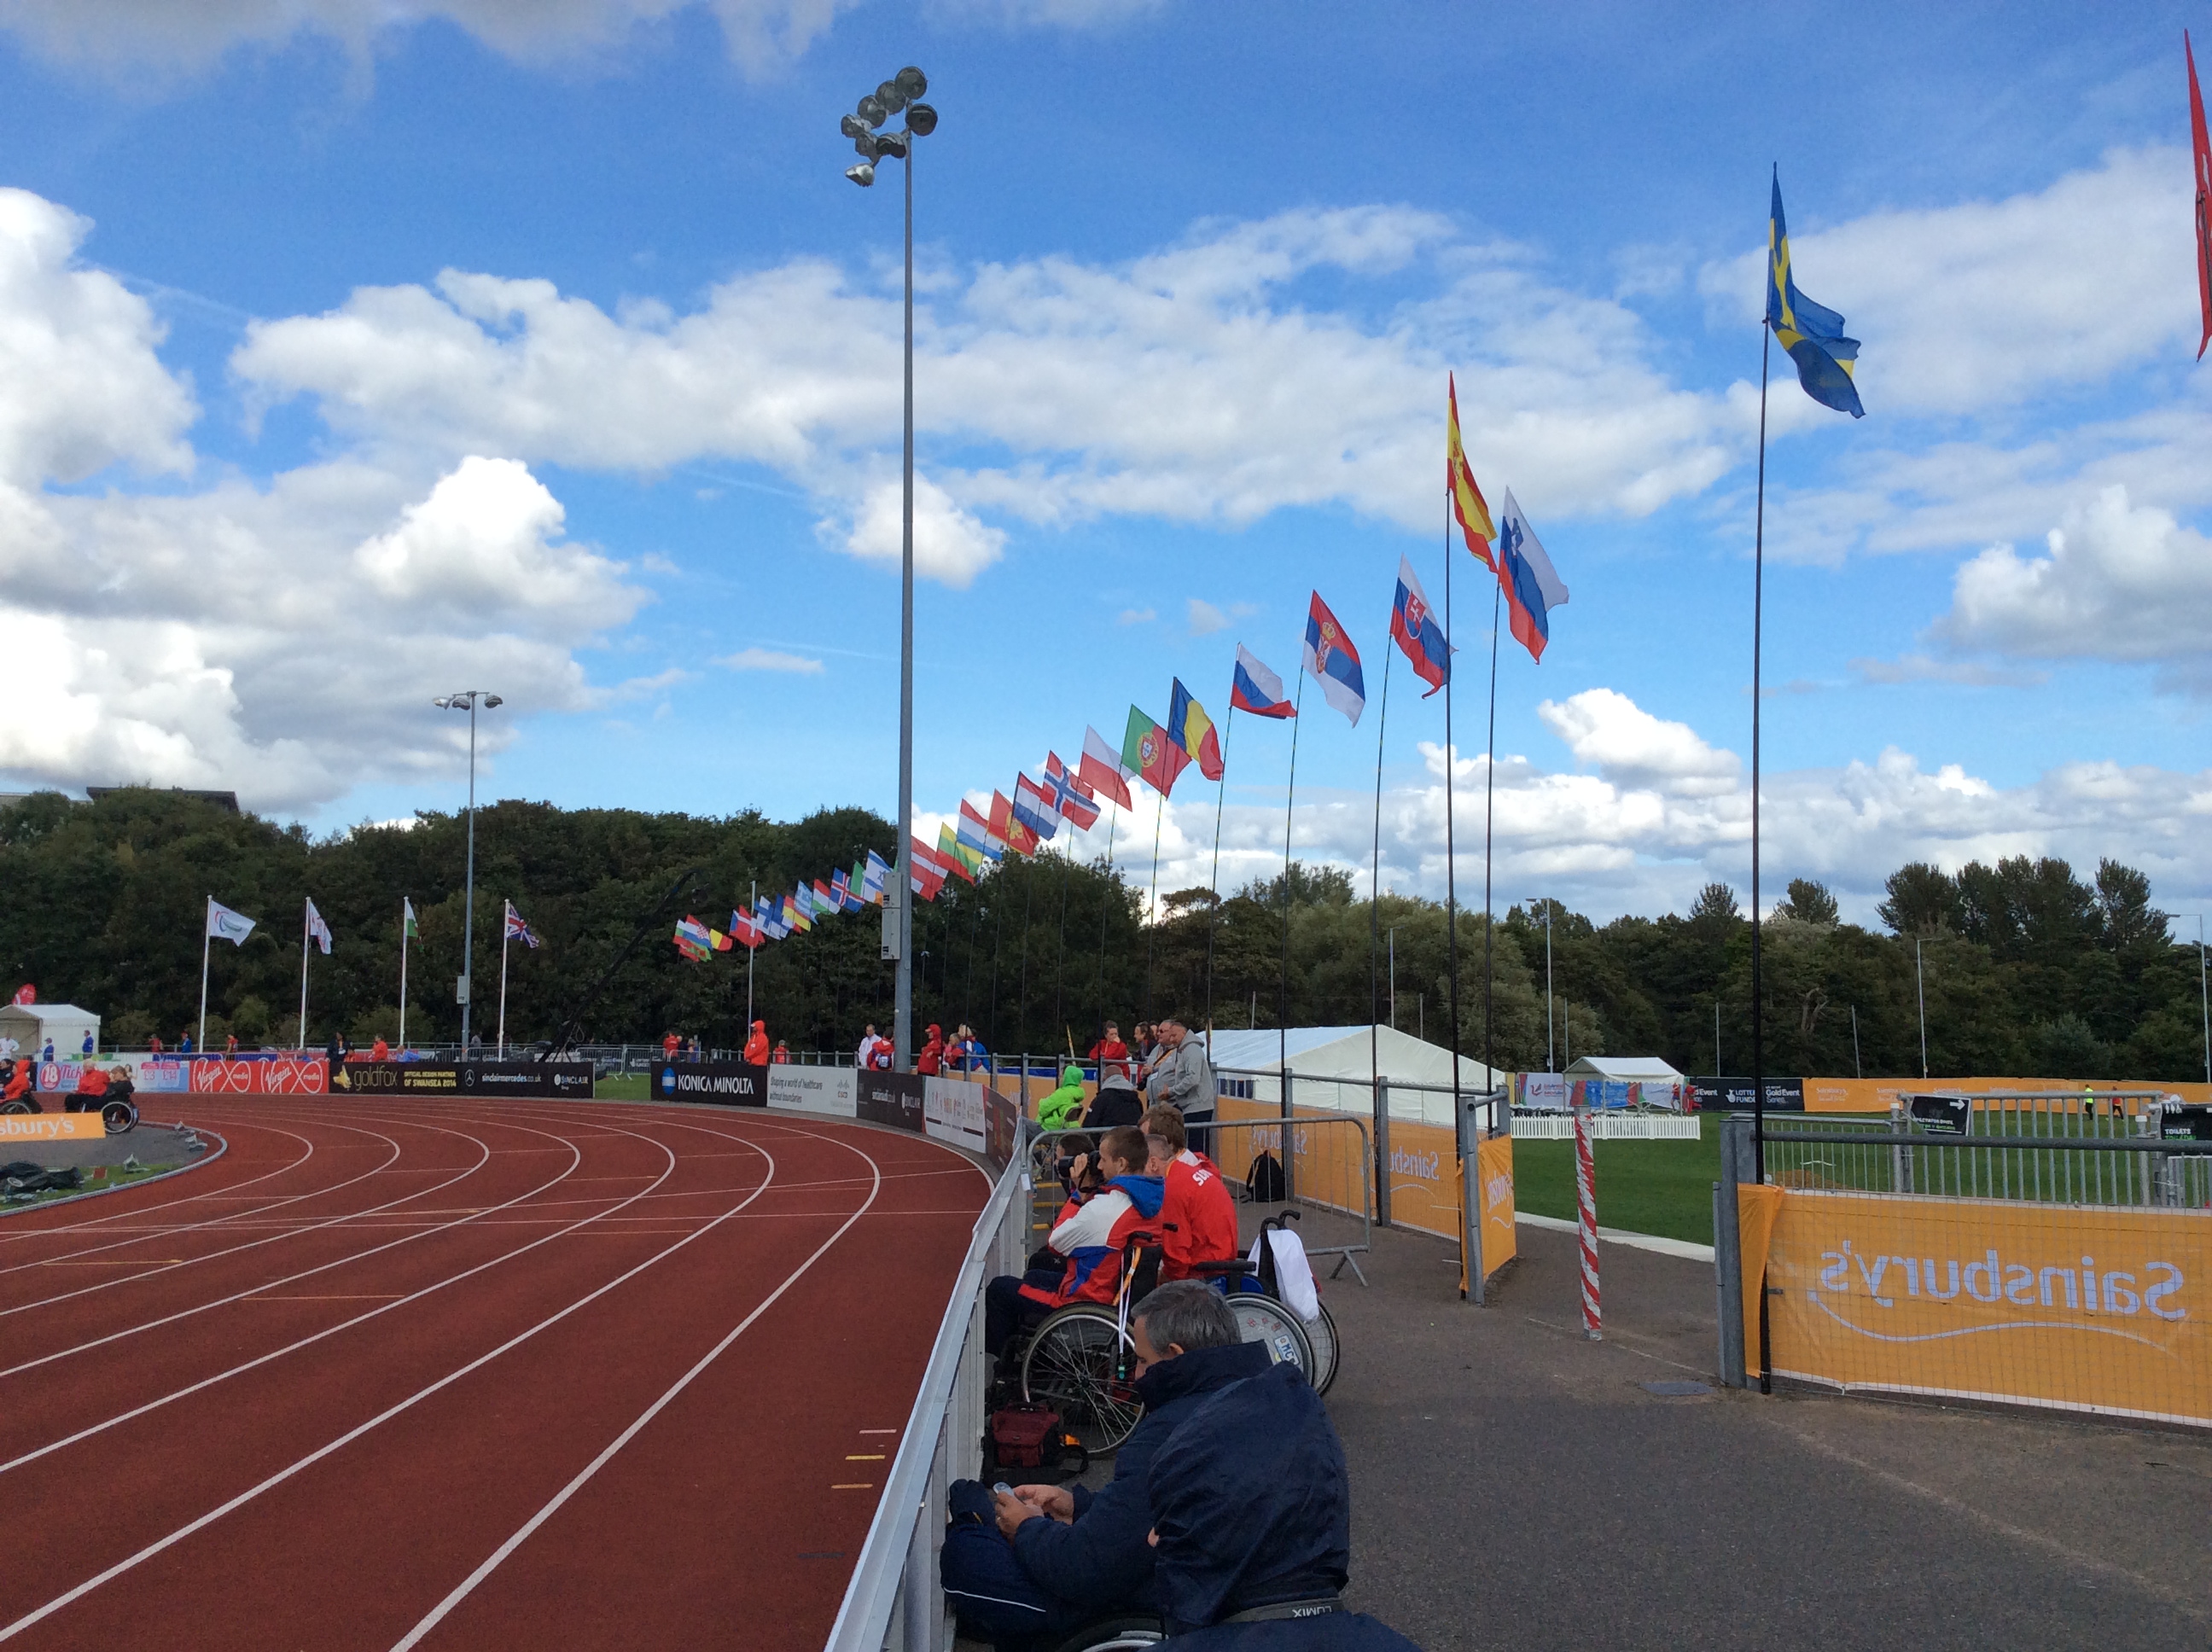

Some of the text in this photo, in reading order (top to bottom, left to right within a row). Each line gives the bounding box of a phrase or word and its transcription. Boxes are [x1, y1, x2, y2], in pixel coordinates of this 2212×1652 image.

[44, 1065, 59, 1083] 18
[197, 1066, 222, 1090] Virgin
[265, 1067, 292, 1091] Virgin
[353, 1065, 398, 1091] goldfox
[678, 1074, 754, 1095] KONICA MINOLTA
[1292, 1606, 1332, 1618] LUMIX
